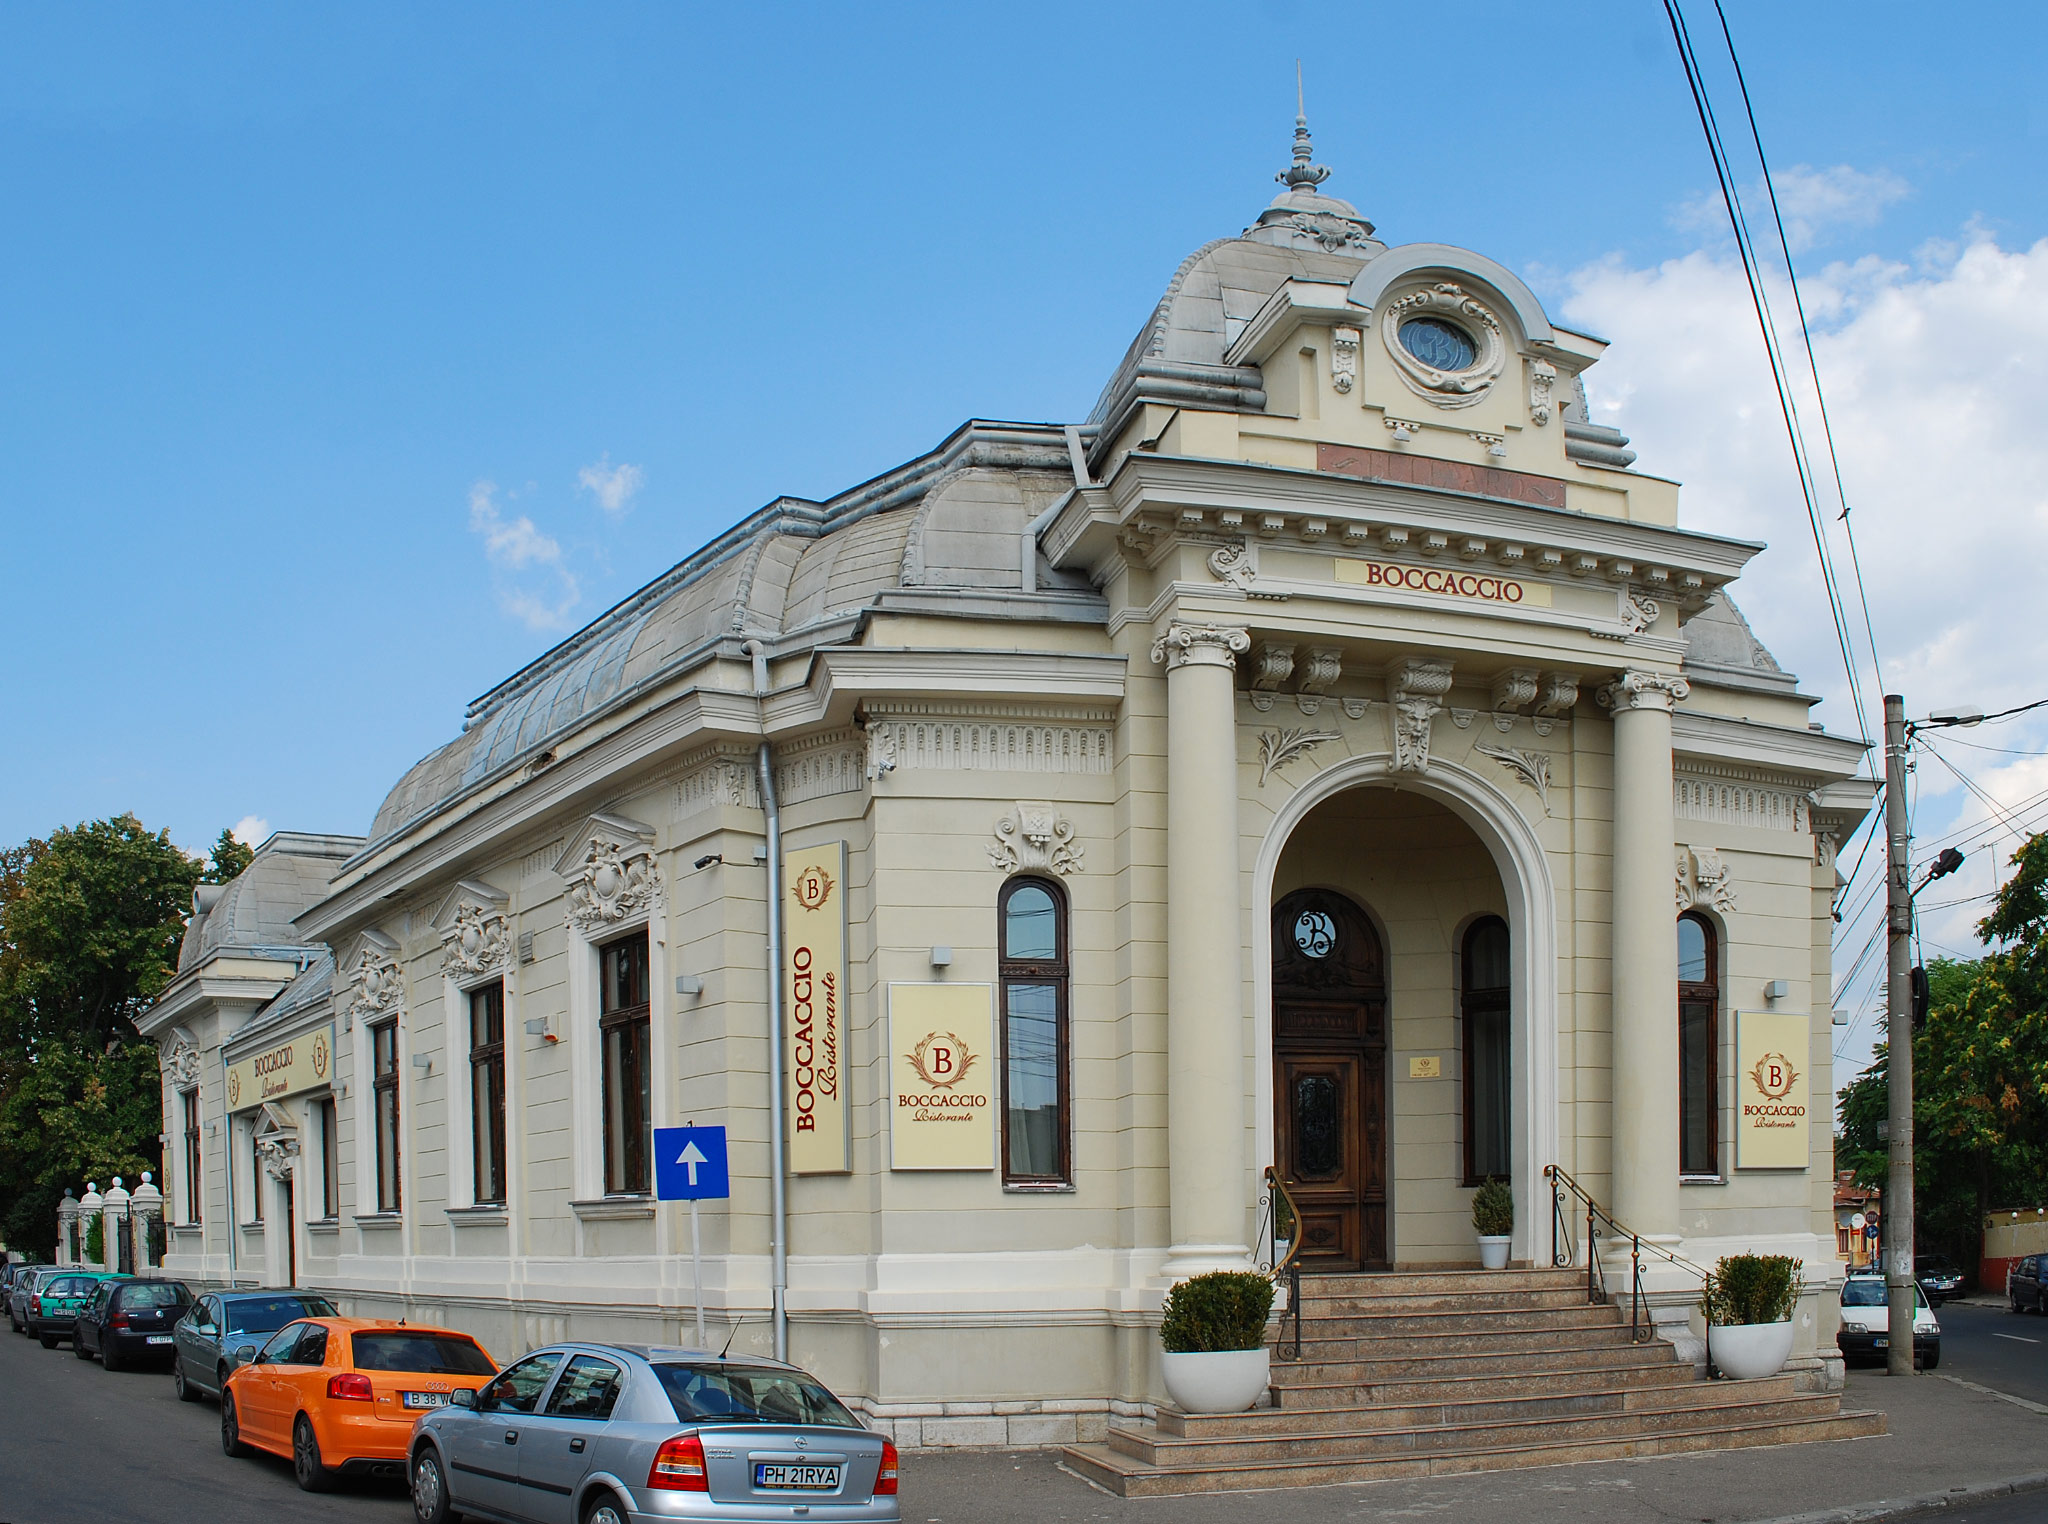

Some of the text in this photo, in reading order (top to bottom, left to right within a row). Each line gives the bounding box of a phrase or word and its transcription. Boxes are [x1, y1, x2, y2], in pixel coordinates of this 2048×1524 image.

[1366, 563, 1523, 603] BOCCACCIO
[806, 878, 819, 900] B
[793, 946, 815, 1133] BOCCACCIO
[817, 970, 837, 1102] Ristorante
[254, 1046, 293, 1078] BOCCACCIO
[316, 1046, 323, 1067] B
[932, 1047, 953, 1074] B
[1767, 1064, 1783, 1088] B
[898, 1094, 987, 1107] BOCCACCIO
[1743, 1104, 1806, 1117] BOCCACCIO
[912, 1108, 973, 1122] Ristorante
[1753, 1116, 1796, 1128] Ristorante
[412, 1393, 420, 1404] B
[424, 1393, 436, 1405] 38
[764, 1467, 836, 1484] PH 21RYA
